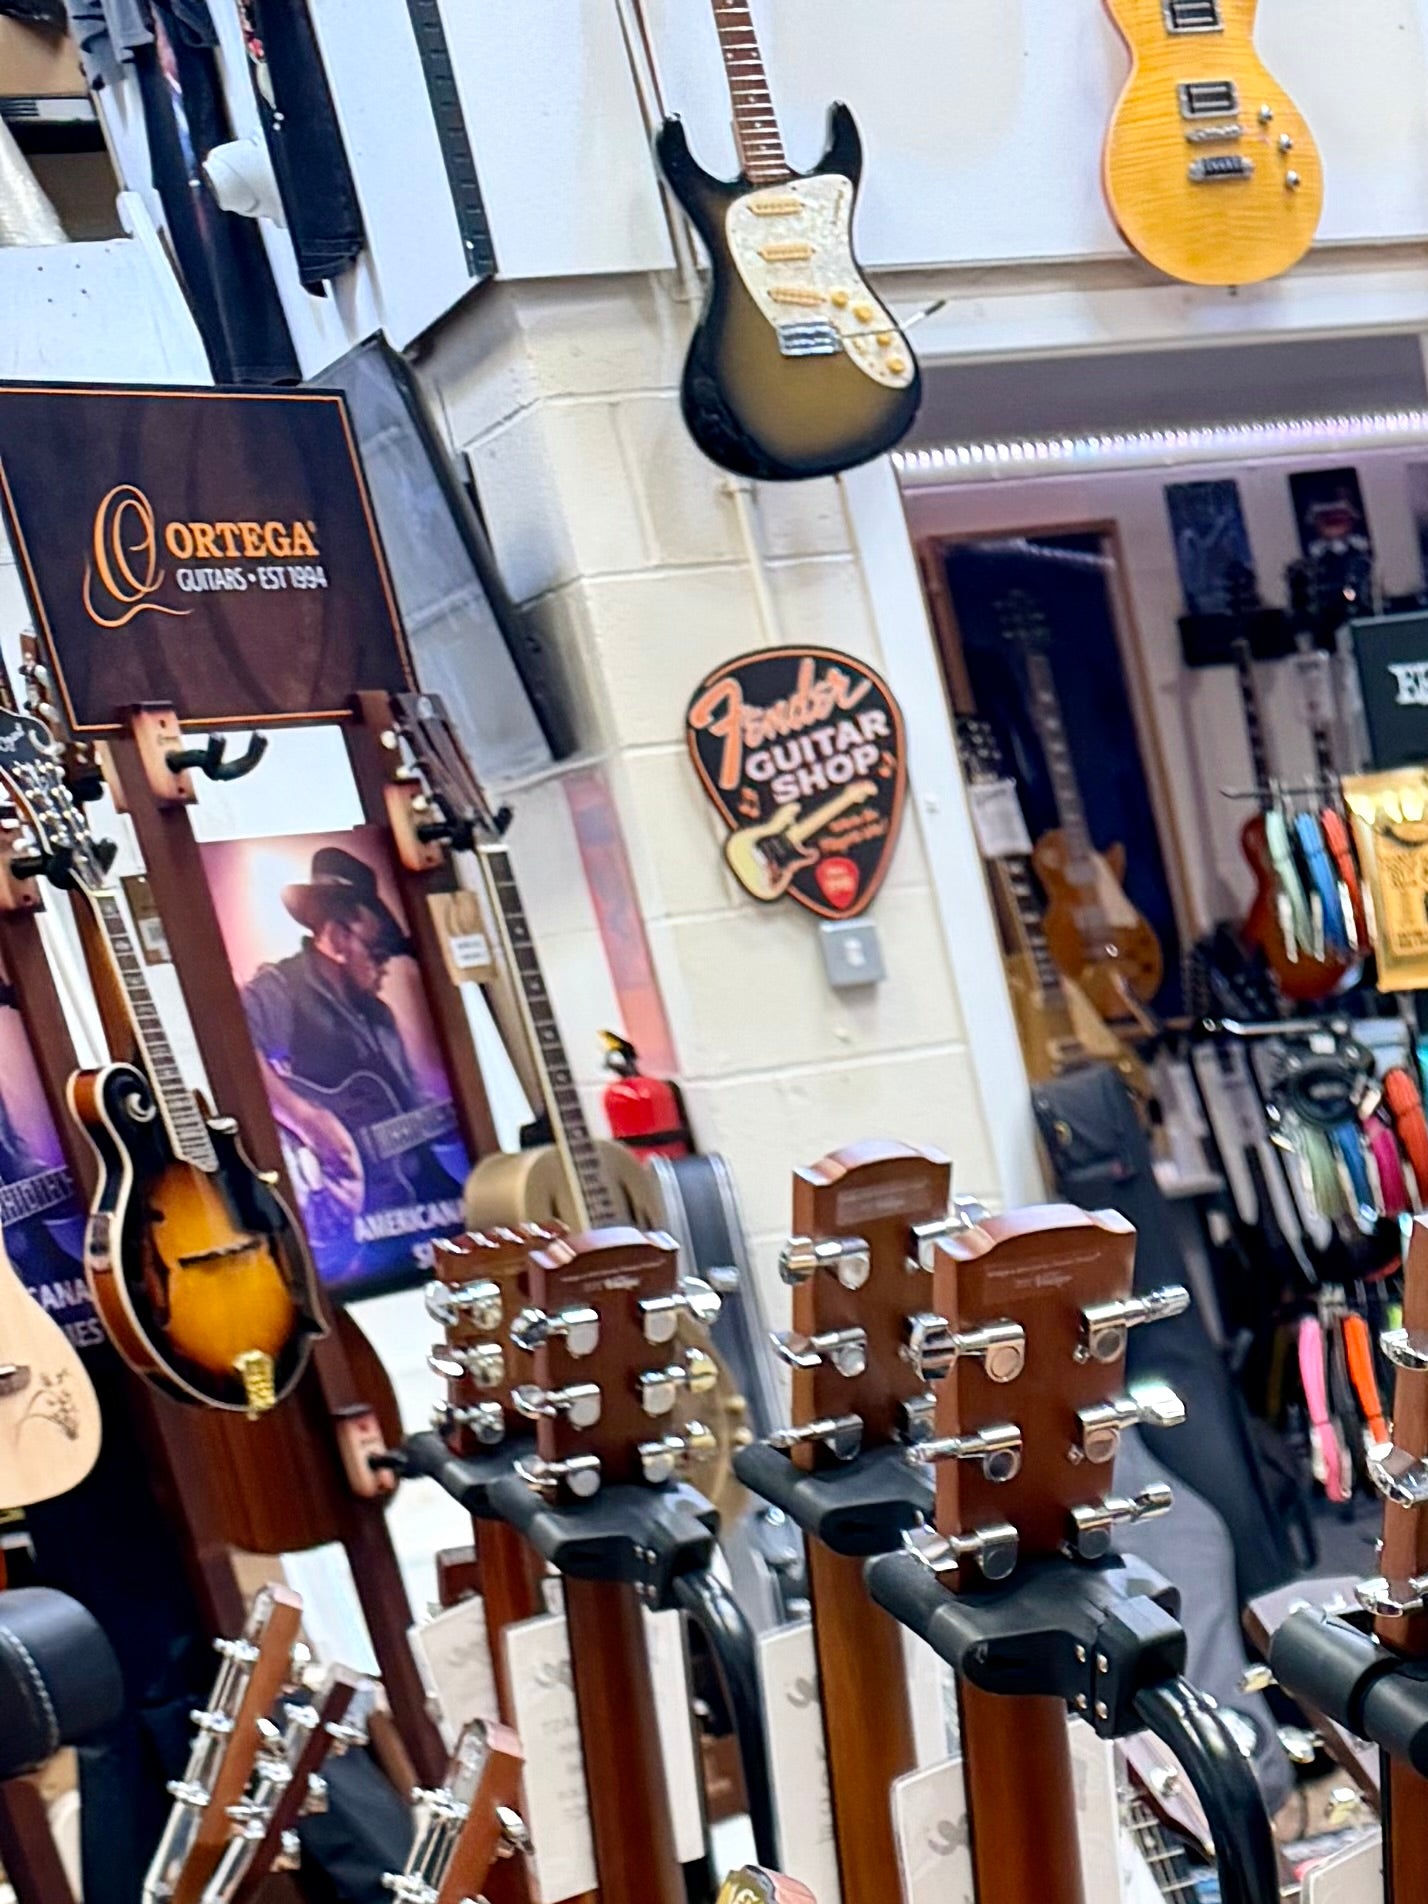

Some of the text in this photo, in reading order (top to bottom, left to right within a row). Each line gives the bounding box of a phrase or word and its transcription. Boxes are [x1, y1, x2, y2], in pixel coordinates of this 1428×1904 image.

[165, 520, 320, 560] ORTEGA
[176, 566, 249, 592] GUITARS
[288, 565, 329, 589] 1994
[688, 656, 873, 791] Fender
[744, 709, 891, 783] GUITAR
[770, 743, 880, 805] SHOP
